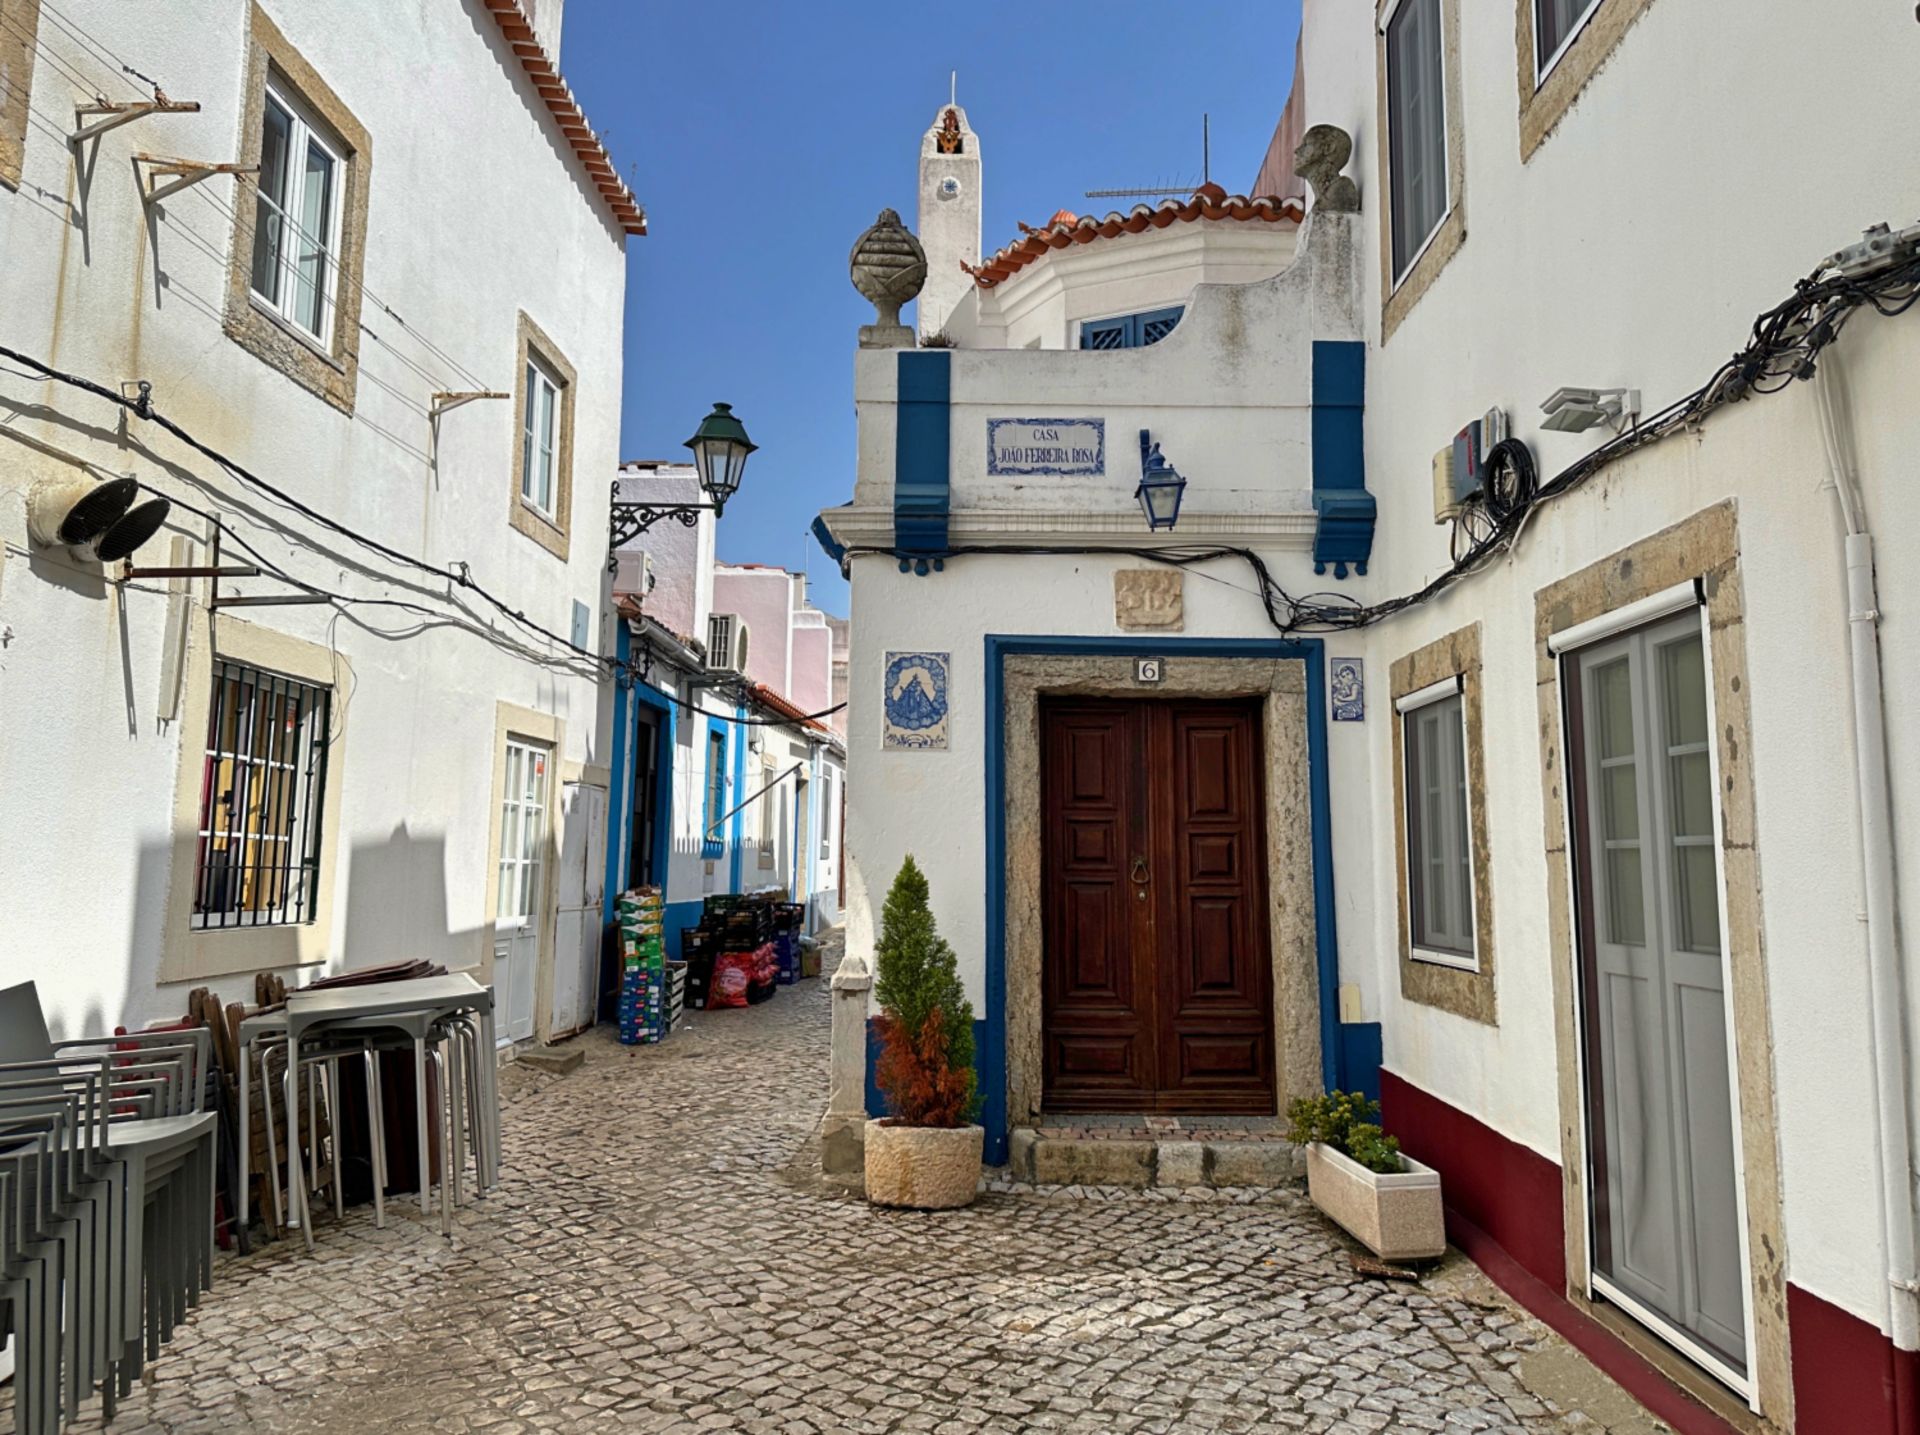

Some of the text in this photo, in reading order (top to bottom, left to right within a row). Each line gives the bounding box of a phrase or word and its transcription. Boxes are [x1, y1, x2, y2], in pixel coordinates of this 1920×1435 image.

[1033, 428, 1059, 441] CASA
[998, 446, 1094, 464] JOÃO FERREIRA ROSA
[1142, 662, 1156, 679] 6
